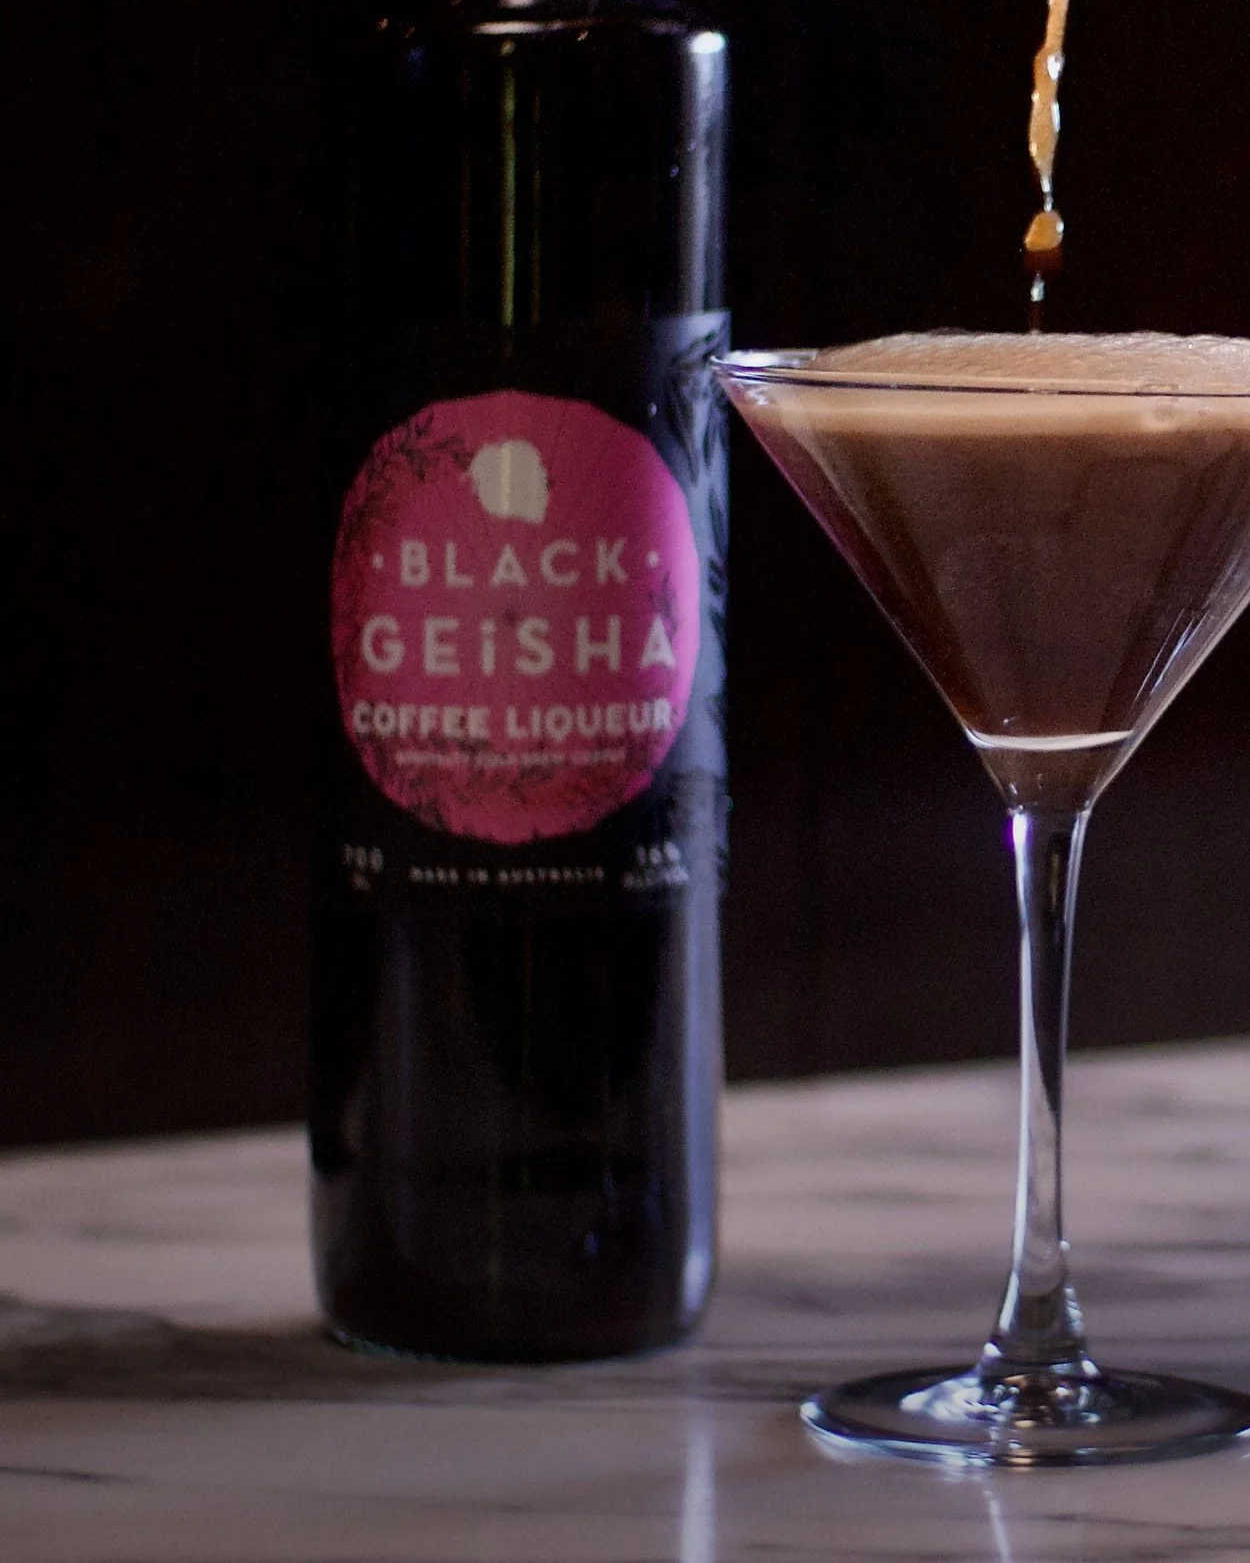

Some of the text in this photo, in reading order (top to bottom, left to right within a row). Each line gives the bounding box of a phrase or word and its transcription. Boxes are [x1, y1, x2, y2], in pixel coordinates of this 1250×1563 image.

[400, 539, 628, 588] BLACK
[352, 698, 673, 740] COFFEE LIQUEUR
